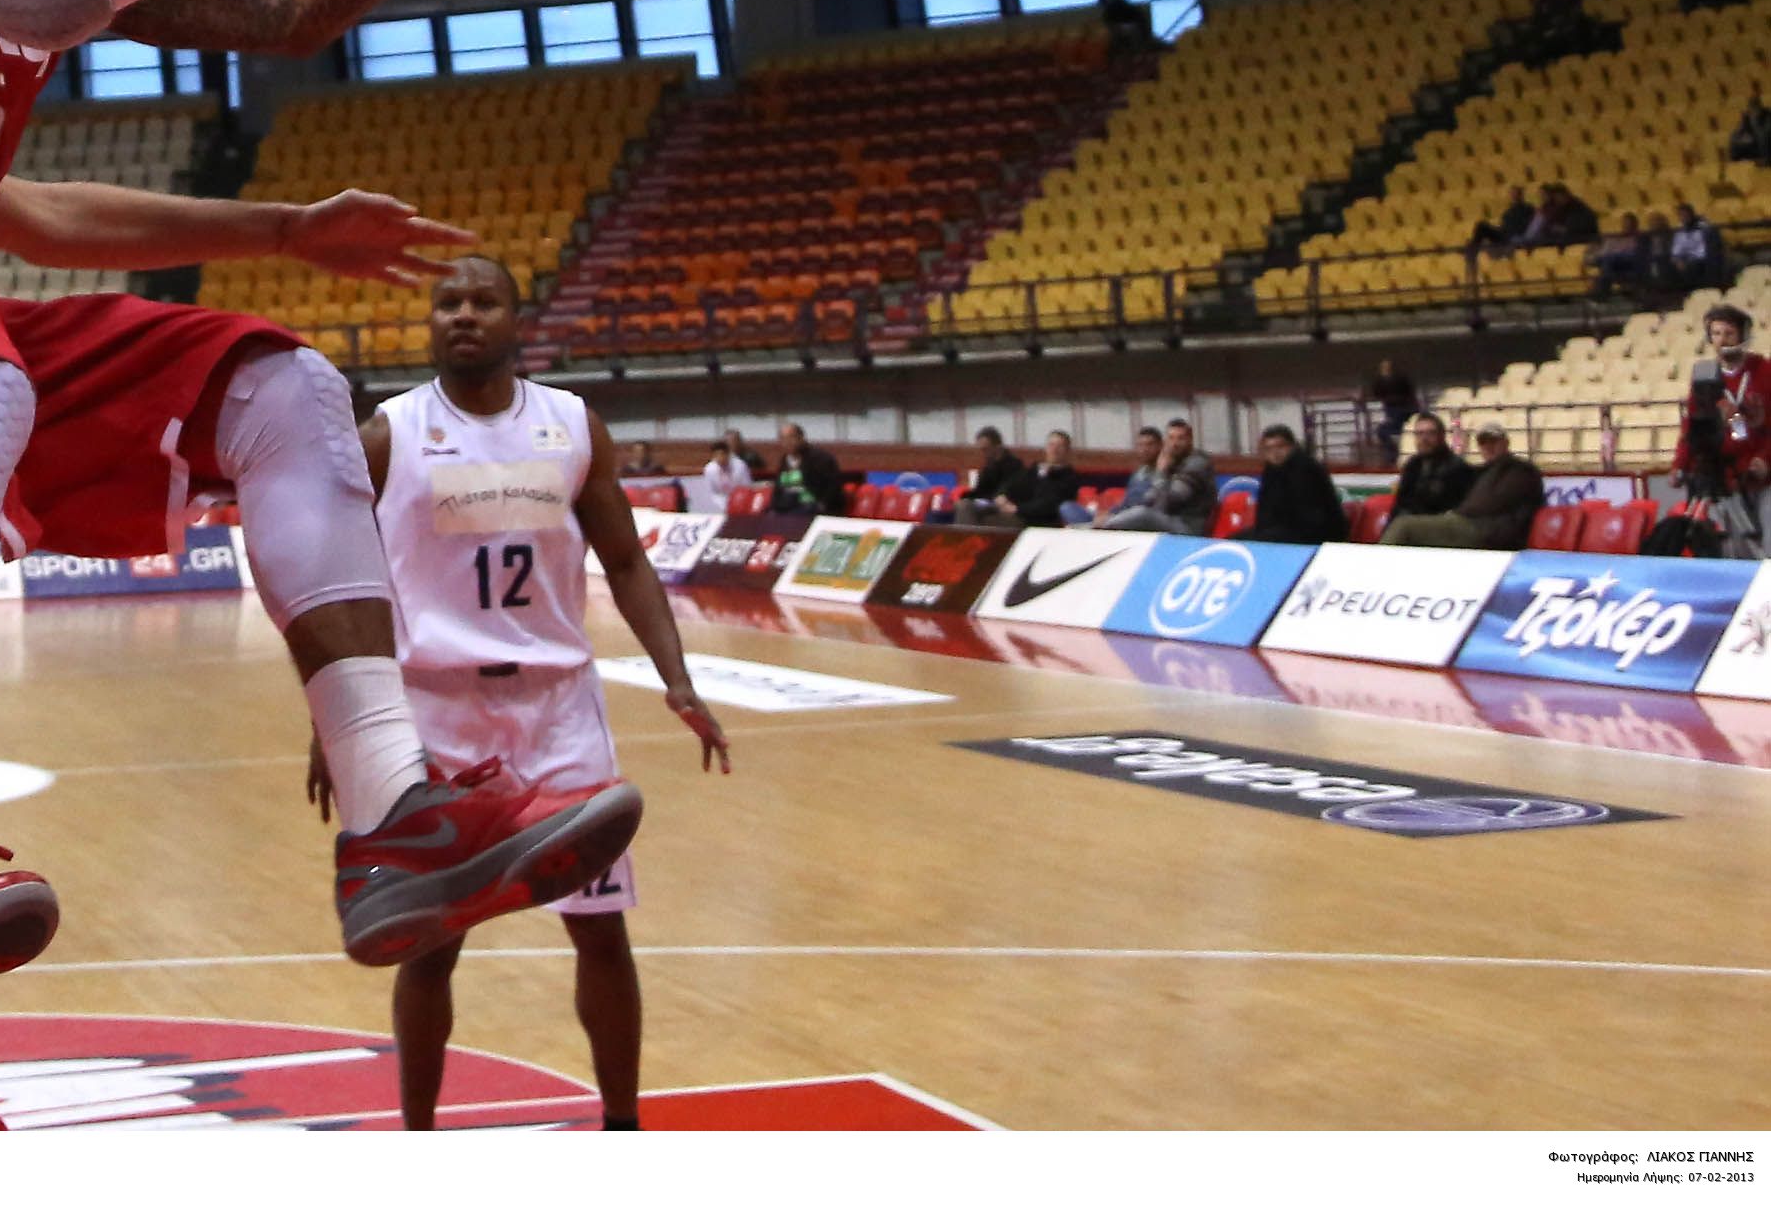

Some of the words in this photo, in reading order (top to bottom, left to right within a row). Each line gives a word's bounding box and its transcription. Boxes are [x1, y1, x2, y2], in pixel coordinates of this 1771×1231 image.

[474, 544, 534, 610] 12
[1320, 589, 1478, 621] PEUGEOT
[1503, 570, 1694, 672] Τζόκερ
